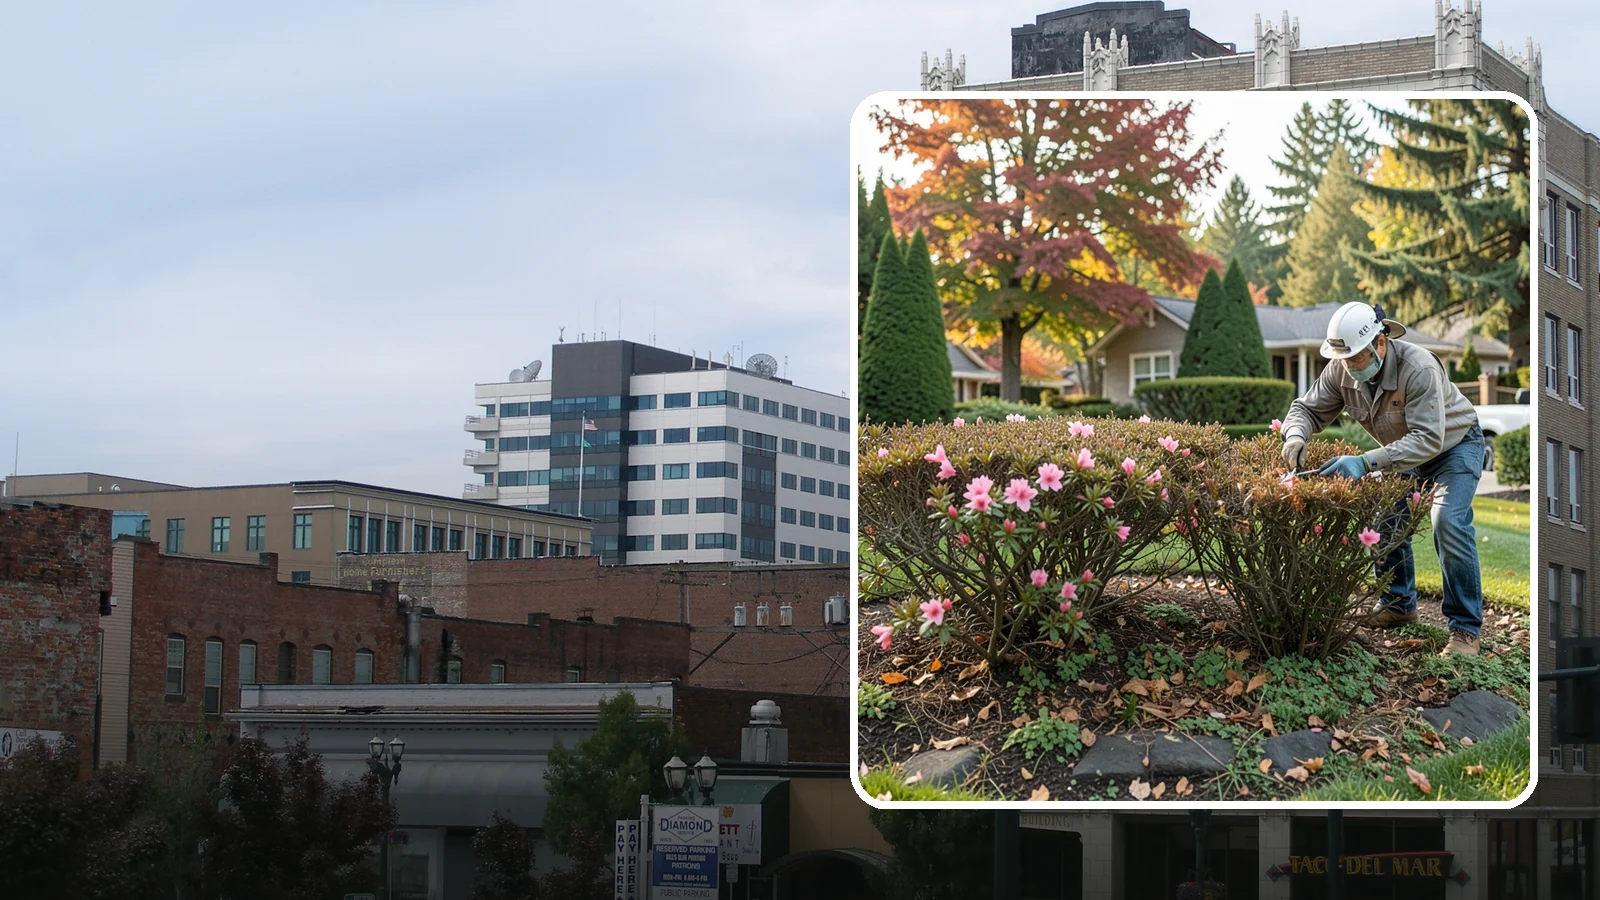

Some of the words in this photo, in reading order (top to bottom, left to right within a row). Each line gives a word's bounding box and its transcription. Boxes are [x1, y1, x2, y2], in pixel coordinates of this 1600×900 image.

[343, 568, 368, 577] Home
[370, 566, 426, 577] Furnishers
[660, 818, 713, 833] DIAMOND
[1022, 815, 1070, 827] BUILDING
[617, 824, 625, 853] PAY
[628, 824, 637, 853] PAY
[655, 845, 688, 853] RESERVED
[689, 846, 716, 854] PARKING
[721, 851, 739, 863] Soup
[671, 861, 701, 870] PATRONS
[1289, 855, 1329, 874] TAC
[1346, 856, 1384, 876] DEL
[1392, 857, 1442, 877] MAR
[616, 855, 625, 893] HERE
[627, 855, 636, 893] HERE
[660, 888, 682, 897] PUBLIC
[683, 889, 710, 898] PARKING
